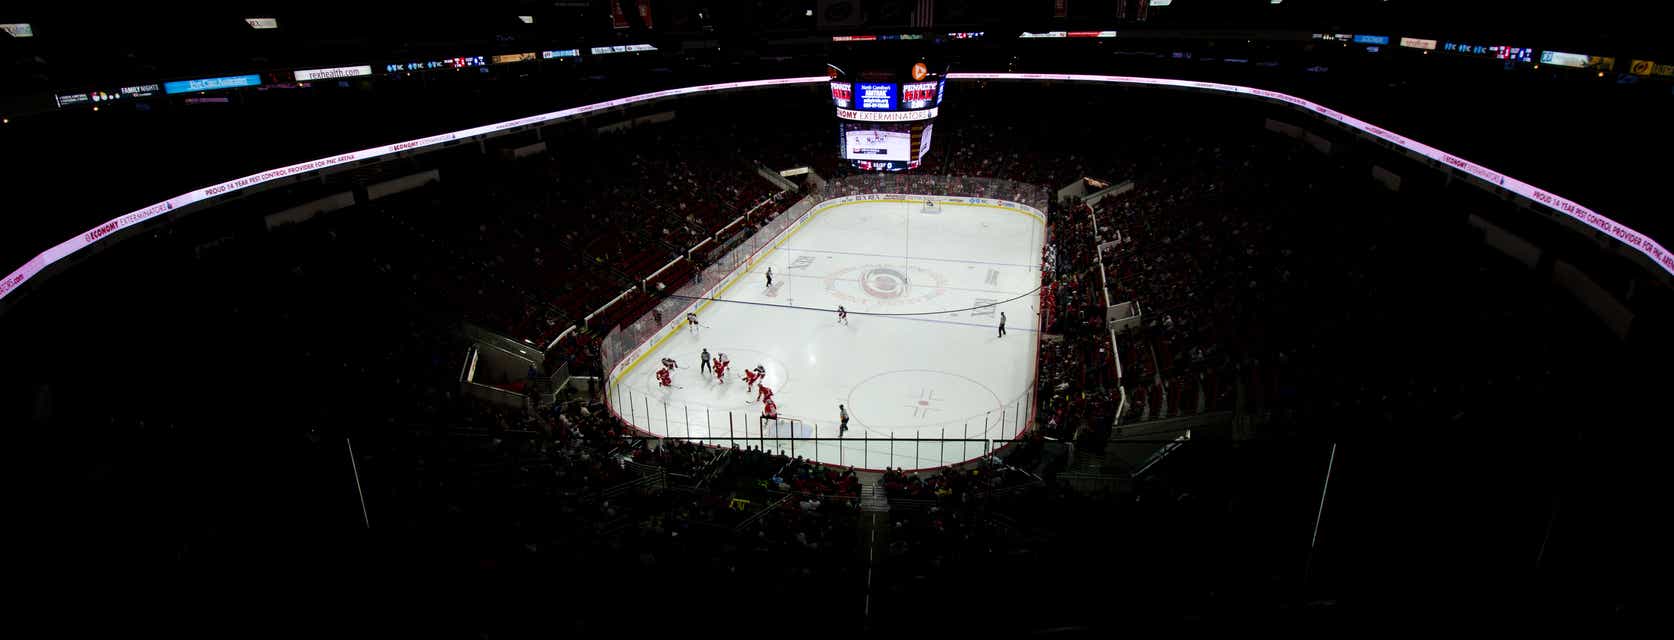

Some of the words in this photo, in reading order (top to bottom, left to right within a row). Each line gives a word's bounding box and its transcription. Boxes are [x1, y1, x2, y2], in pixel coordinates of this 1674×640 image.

[309, 69, 360, 79] rexhealth.com
[860, 111, 928, 121] EXTERMINATORS
[205, 186, 226, 196] PROUD
[235, 179, 249, 188] YEAR
[250, 176, 262, 184] PEST
[262, 170, 288, 180] CONTROL
[288, 163, 314, 175] PROVIDER
[315, 160, 326, 168] FOR
[338, 155, 355, 163] ARENA
[91, 221, 119, 240] ECONOMY
[1533, 190, 1551, 203] PROUD
[1560, 202, 1575, 213] YEAR
[1575, 208, 1588, 220] PEST
[1587, 214, 1612, 233] CONTROL
[1612, 226, 1642, 246] PROVIDER
[1642, 240, 1654, 253] FOR
